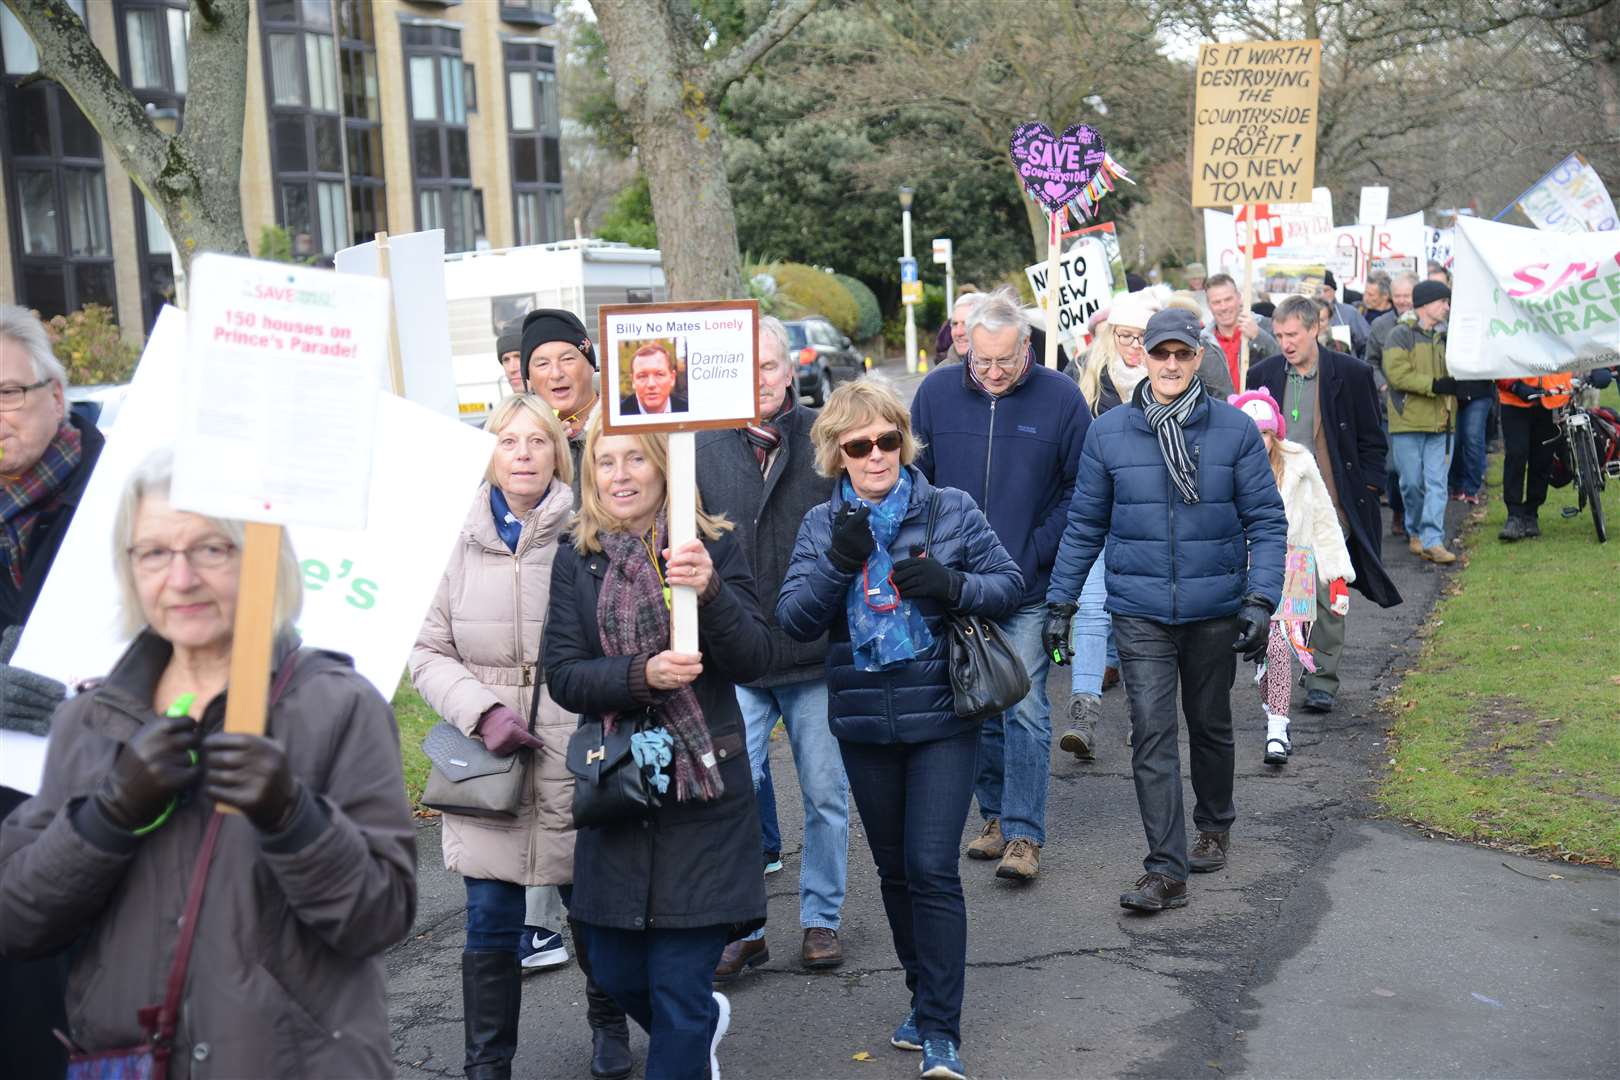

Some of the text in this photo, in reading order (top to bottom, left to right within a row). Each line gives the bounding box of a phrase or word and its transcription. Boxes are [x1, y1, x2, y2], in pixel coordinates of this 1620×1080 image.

[1202, 45, 1313, 66] IS IT WORTH
[1200, 68, 1312, 88] DESTROYING
[1238, 88, 1274, 103] THE
[1197, 105, 1311, 125] COUNTRYSIDE
[1235, 125, 1269, 137] FOR
[1027, 140, 1080, 170] SAVE
[1020, 162, 1090, 184] COUNTRYSIDE!
[1202, 158, 1303, 181] NO NEW
[1032, 256, 1086, 291] N TO
[255, 284, 295, 303] SAVE
[1058, 279, 1087, 307] EW
[225, 310, 351, 339] 150 houses on
[1058, 299, 1099, 332] OWN
[616, 318, 744, 336] Billy No Mates Lonely
[213, 326, 357, 358] Prince's Parade!
[691, 351, 744, 366] Damian
[691, 367, 738, 381] Collins
